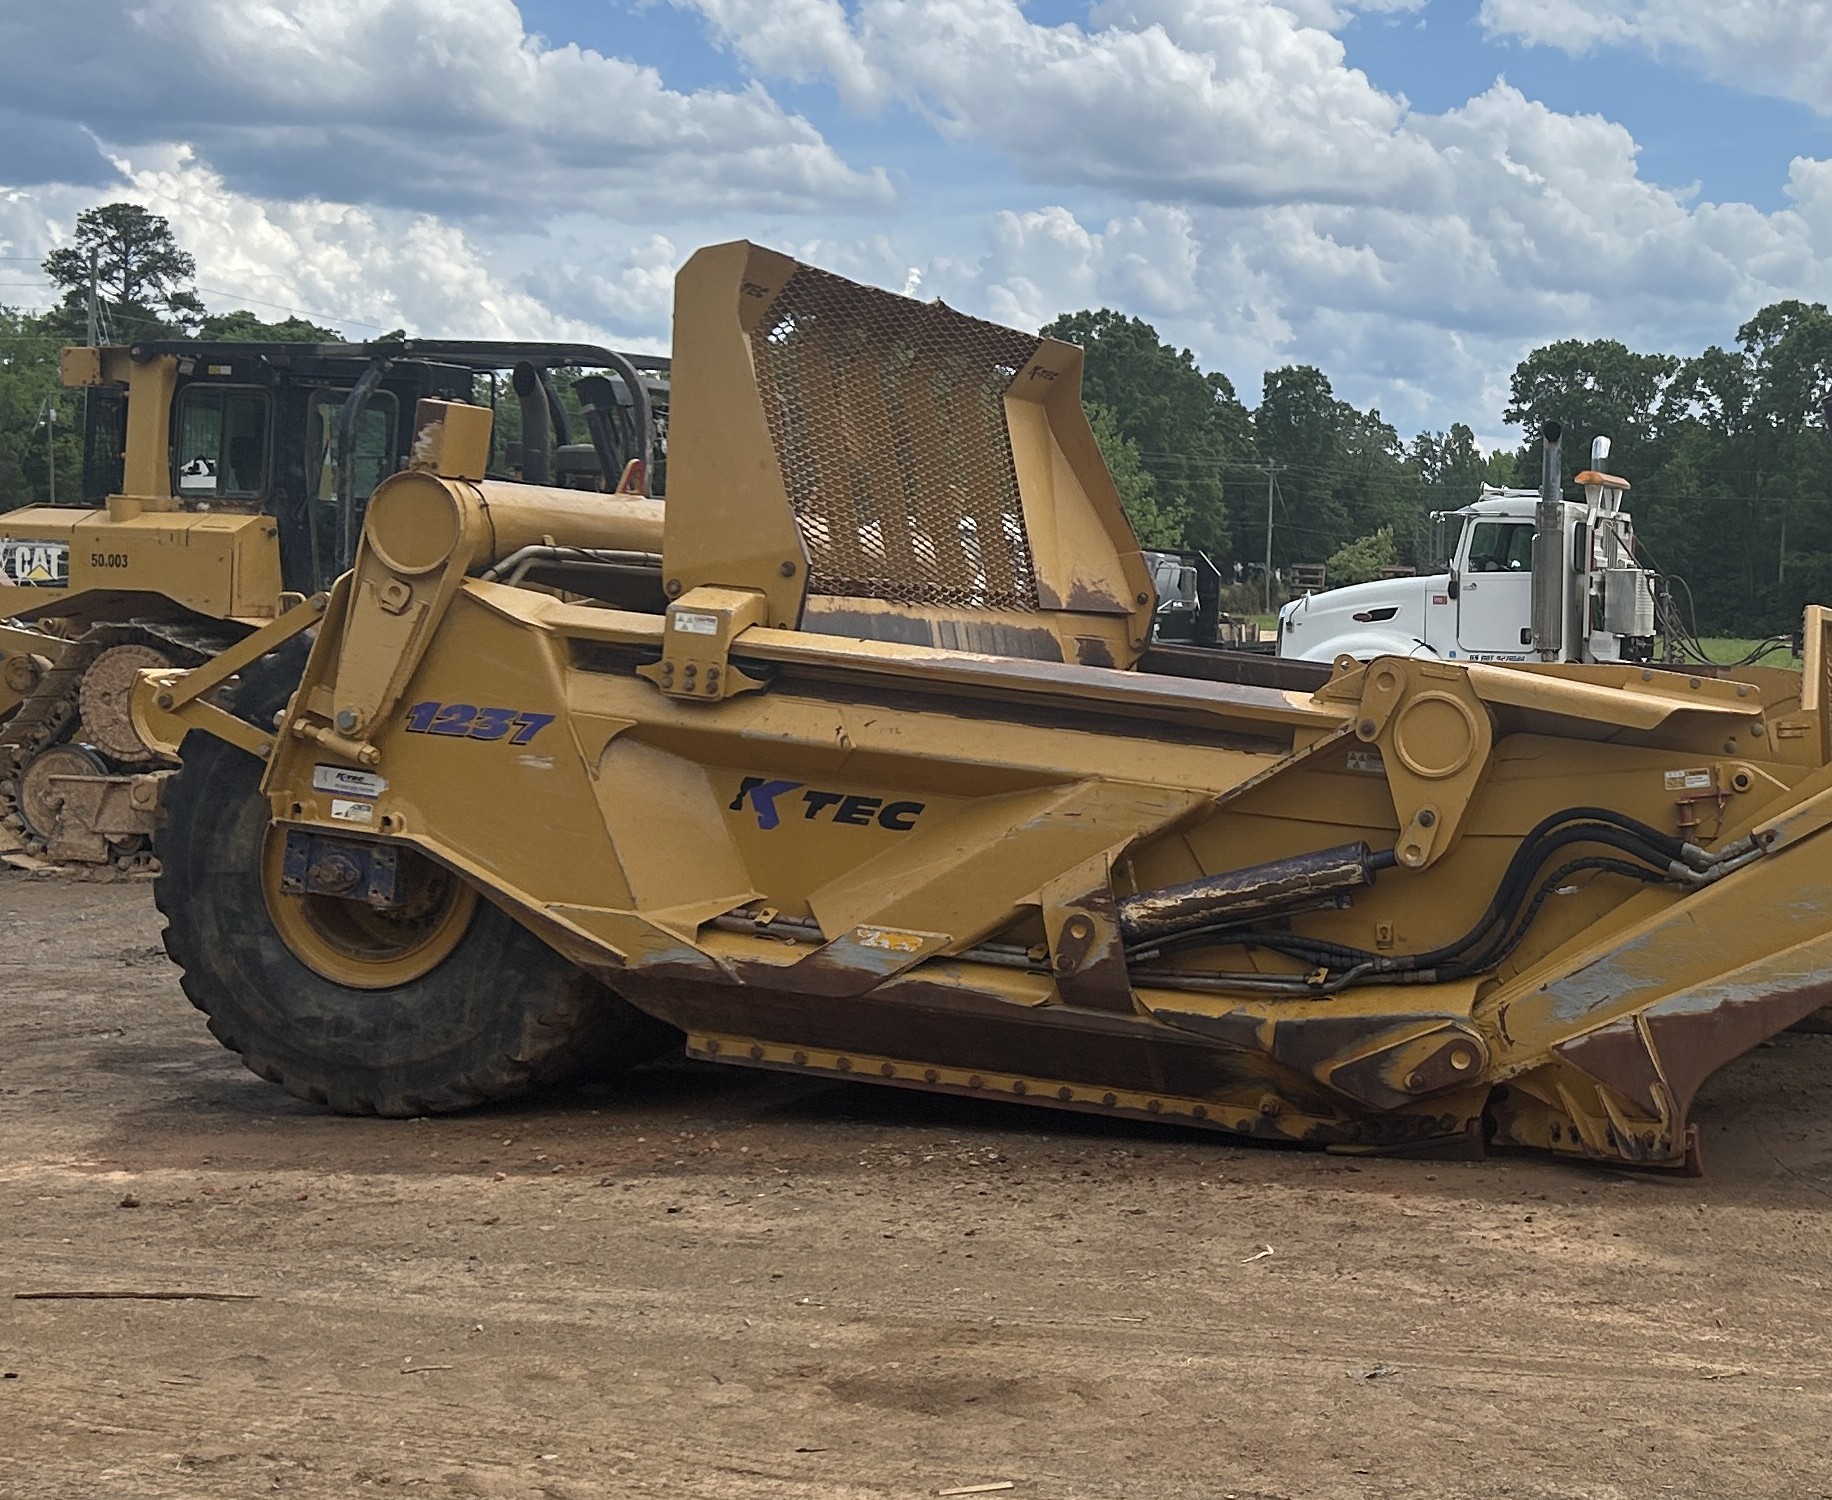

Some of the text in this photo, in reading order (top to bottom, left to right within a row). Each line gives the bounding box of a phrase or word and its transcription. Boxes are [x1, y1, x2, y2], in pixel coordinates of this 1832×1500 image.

[15, 546, 62, 580] CAT
[91, 553, 128, 568] 50.003
[405, 701, 556, 745] 1237
